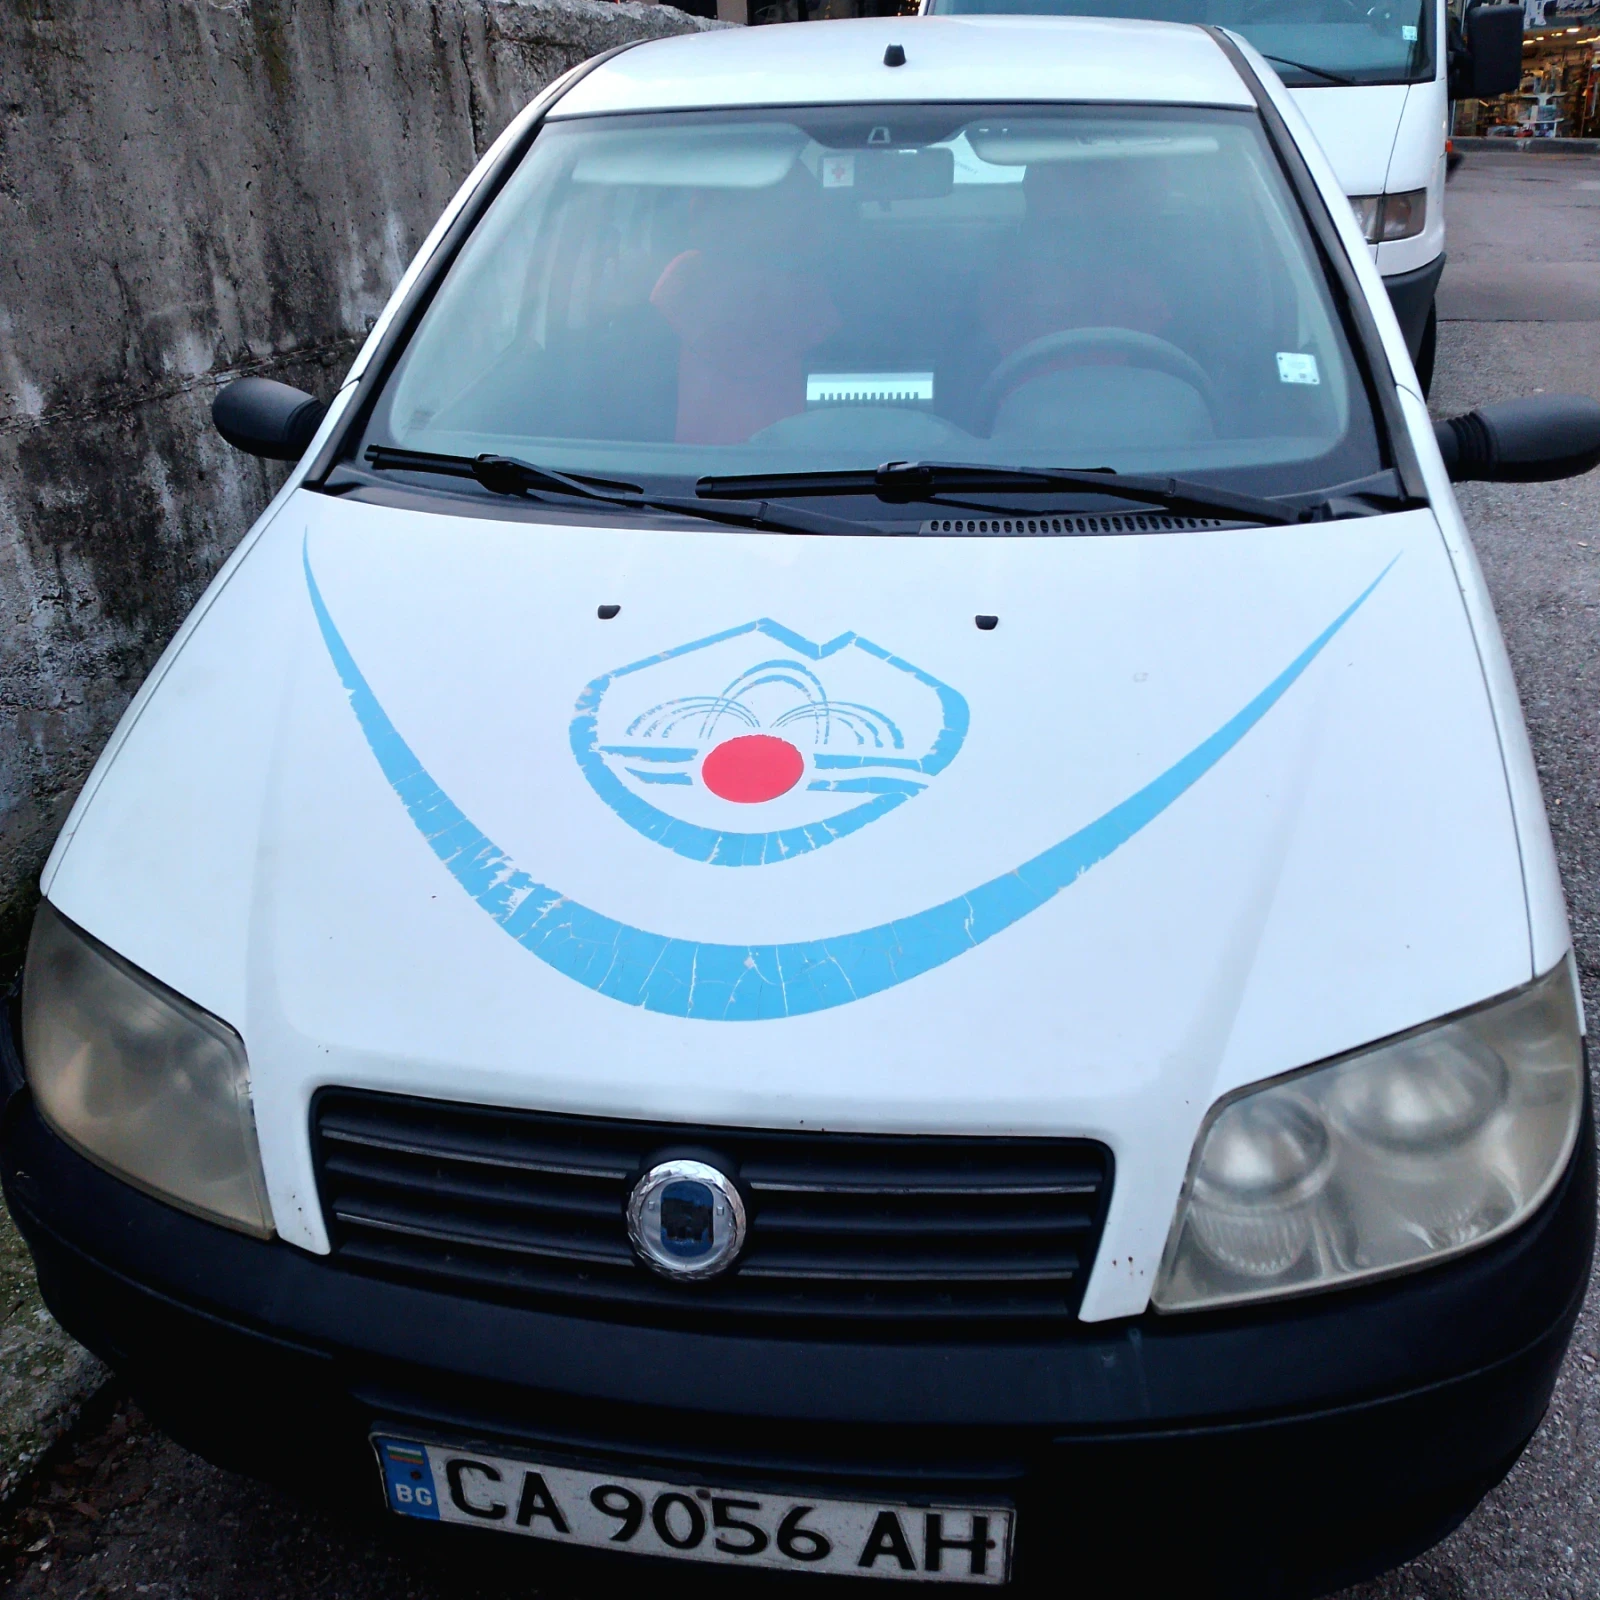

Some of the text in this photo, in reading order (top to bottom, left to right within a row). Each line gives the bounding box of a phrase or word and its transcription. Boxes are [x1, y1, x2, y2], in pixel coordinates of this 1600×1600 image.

[395, 1484, 432, 1506] BG
[445, 1459, 989, 1574] CA 9056 AH
